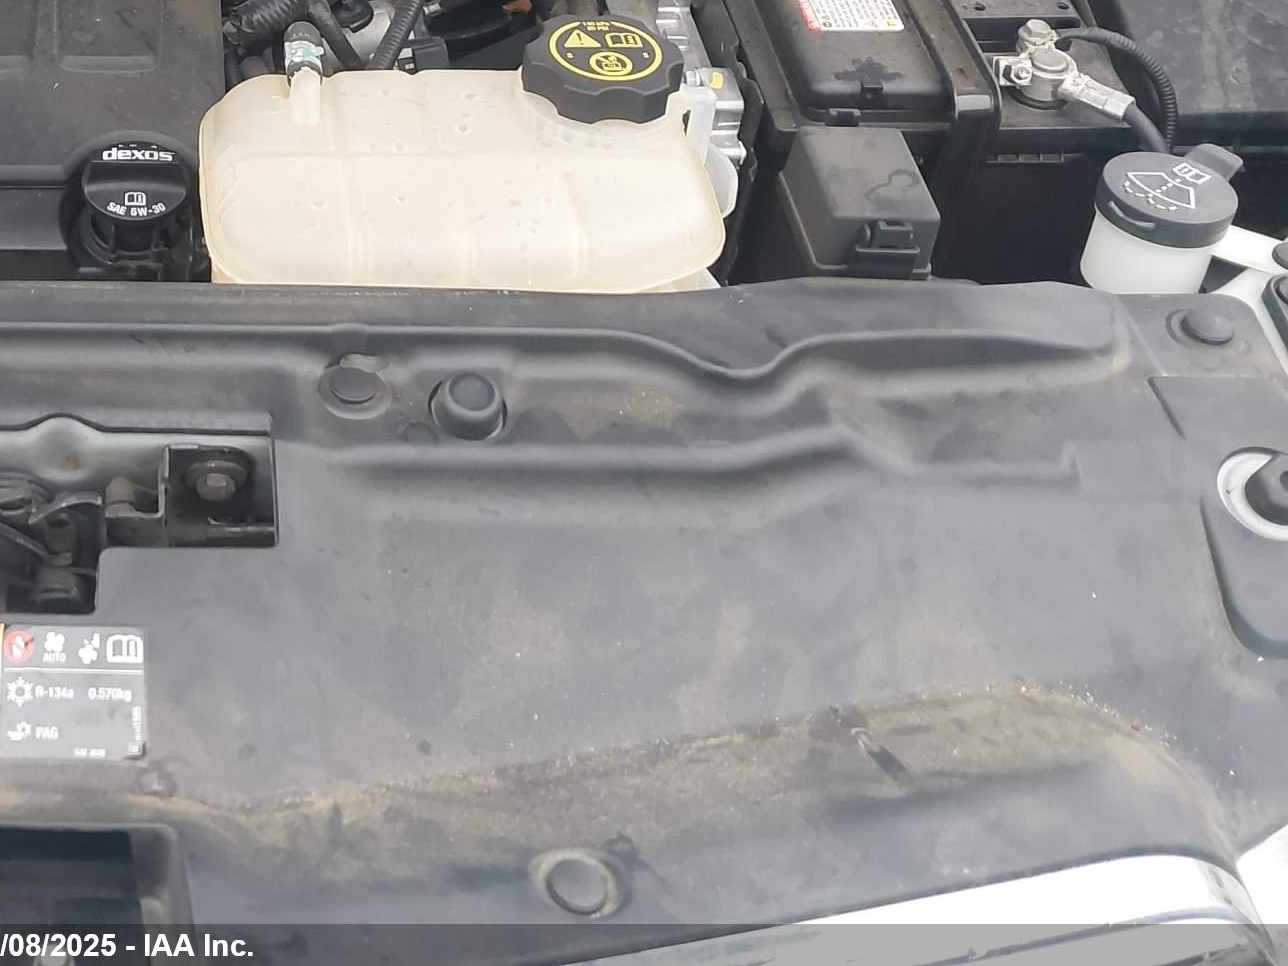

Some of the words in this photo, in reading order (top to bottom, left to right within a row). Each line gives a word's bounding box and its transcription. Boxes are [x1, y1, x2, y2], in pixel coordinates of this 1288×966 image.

[102, 147, 176, 162] dexos
[107, 202, 128, 216] SAE
[42, 652, 67, 663] AUTO
[35, 685, 74, 699] R-134a
[35, 726, 59, 740] PAG
